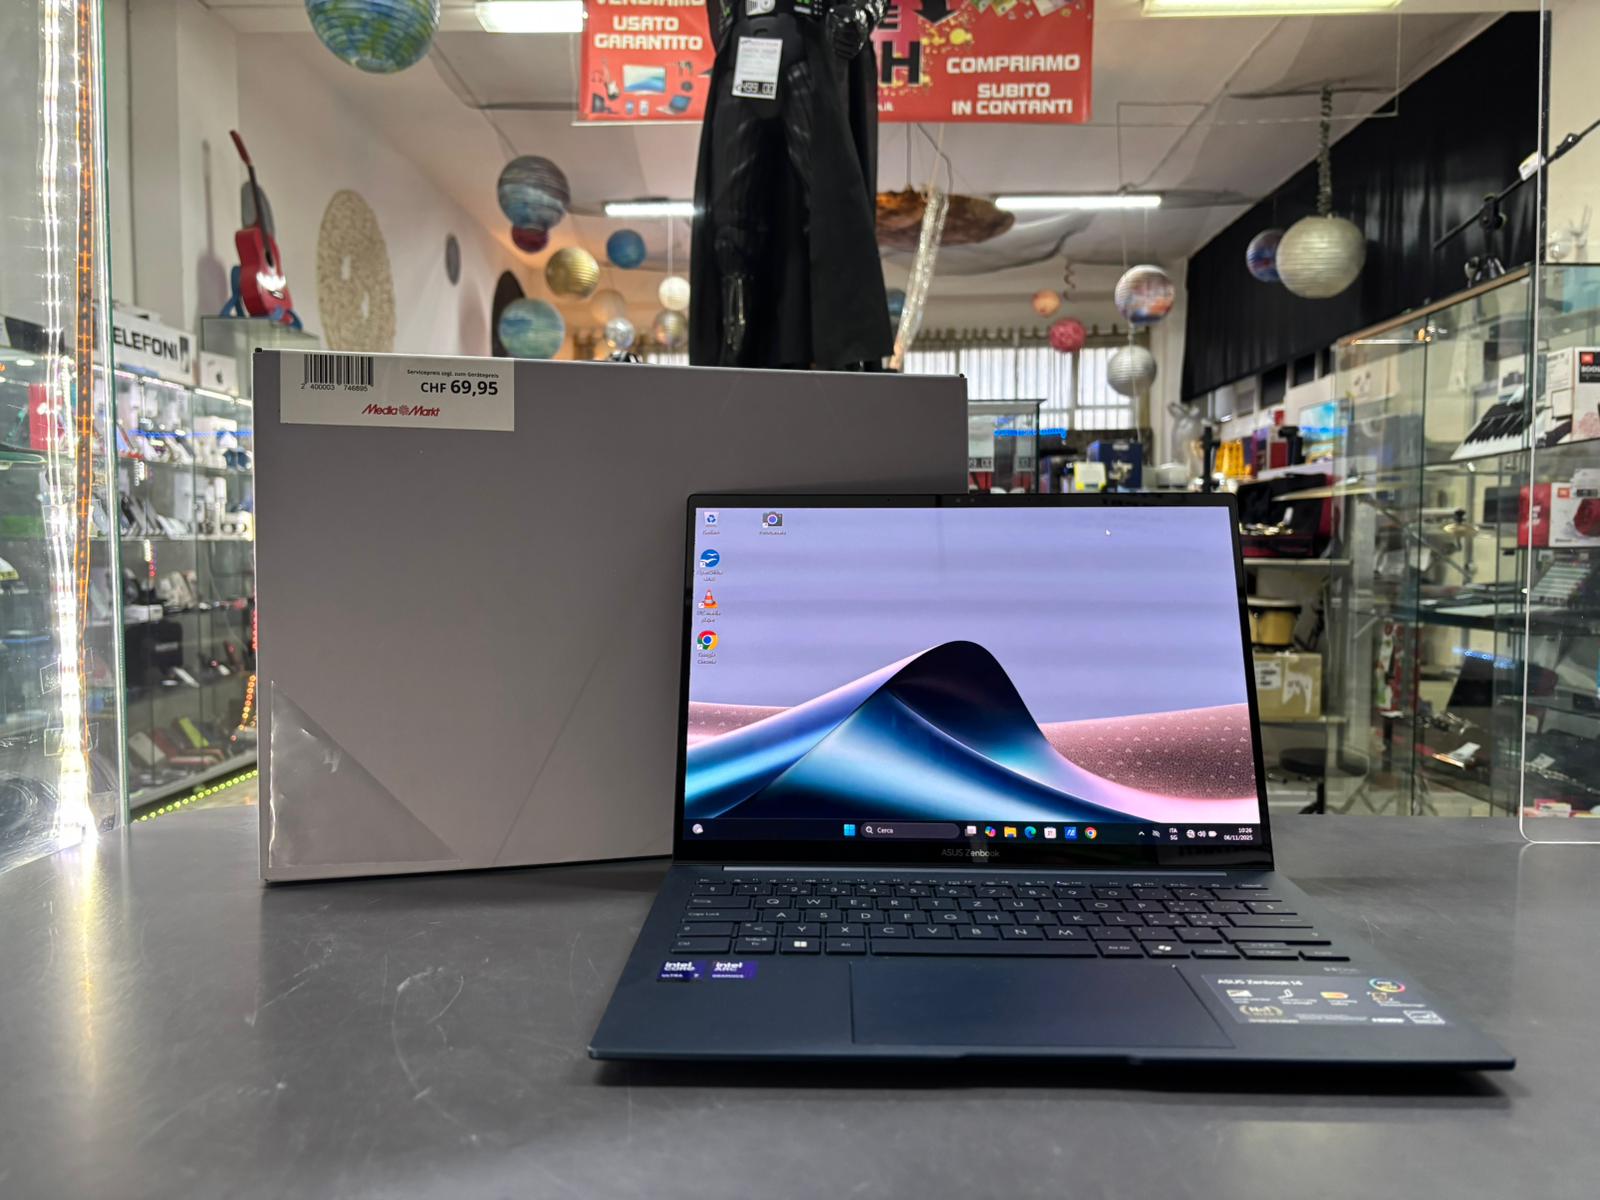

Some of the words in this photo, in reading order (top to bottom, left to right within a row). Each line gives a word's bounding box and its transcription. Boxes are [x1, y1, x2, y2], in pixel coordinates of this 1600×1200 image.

[613, 15, 680, 31] USATO
[594, 33, 703, 50] GARANTITO
[946, 54, 1080, 74] COMPRIAMO
[977, 82, 1050, 98] SUBITO
[952, 100, 972, 115] IN
[976, 99, 1073, 115] CONTANTI
[112, 326, 178, 361] ELEFONI
[310, 383, 335, 391] 400003
[420, 382, 447, 393] CHF
[450, 379, 498, 397] 69,95
[361, 403, 398, 416] Media
[408, 405, 440, 417] Markt
